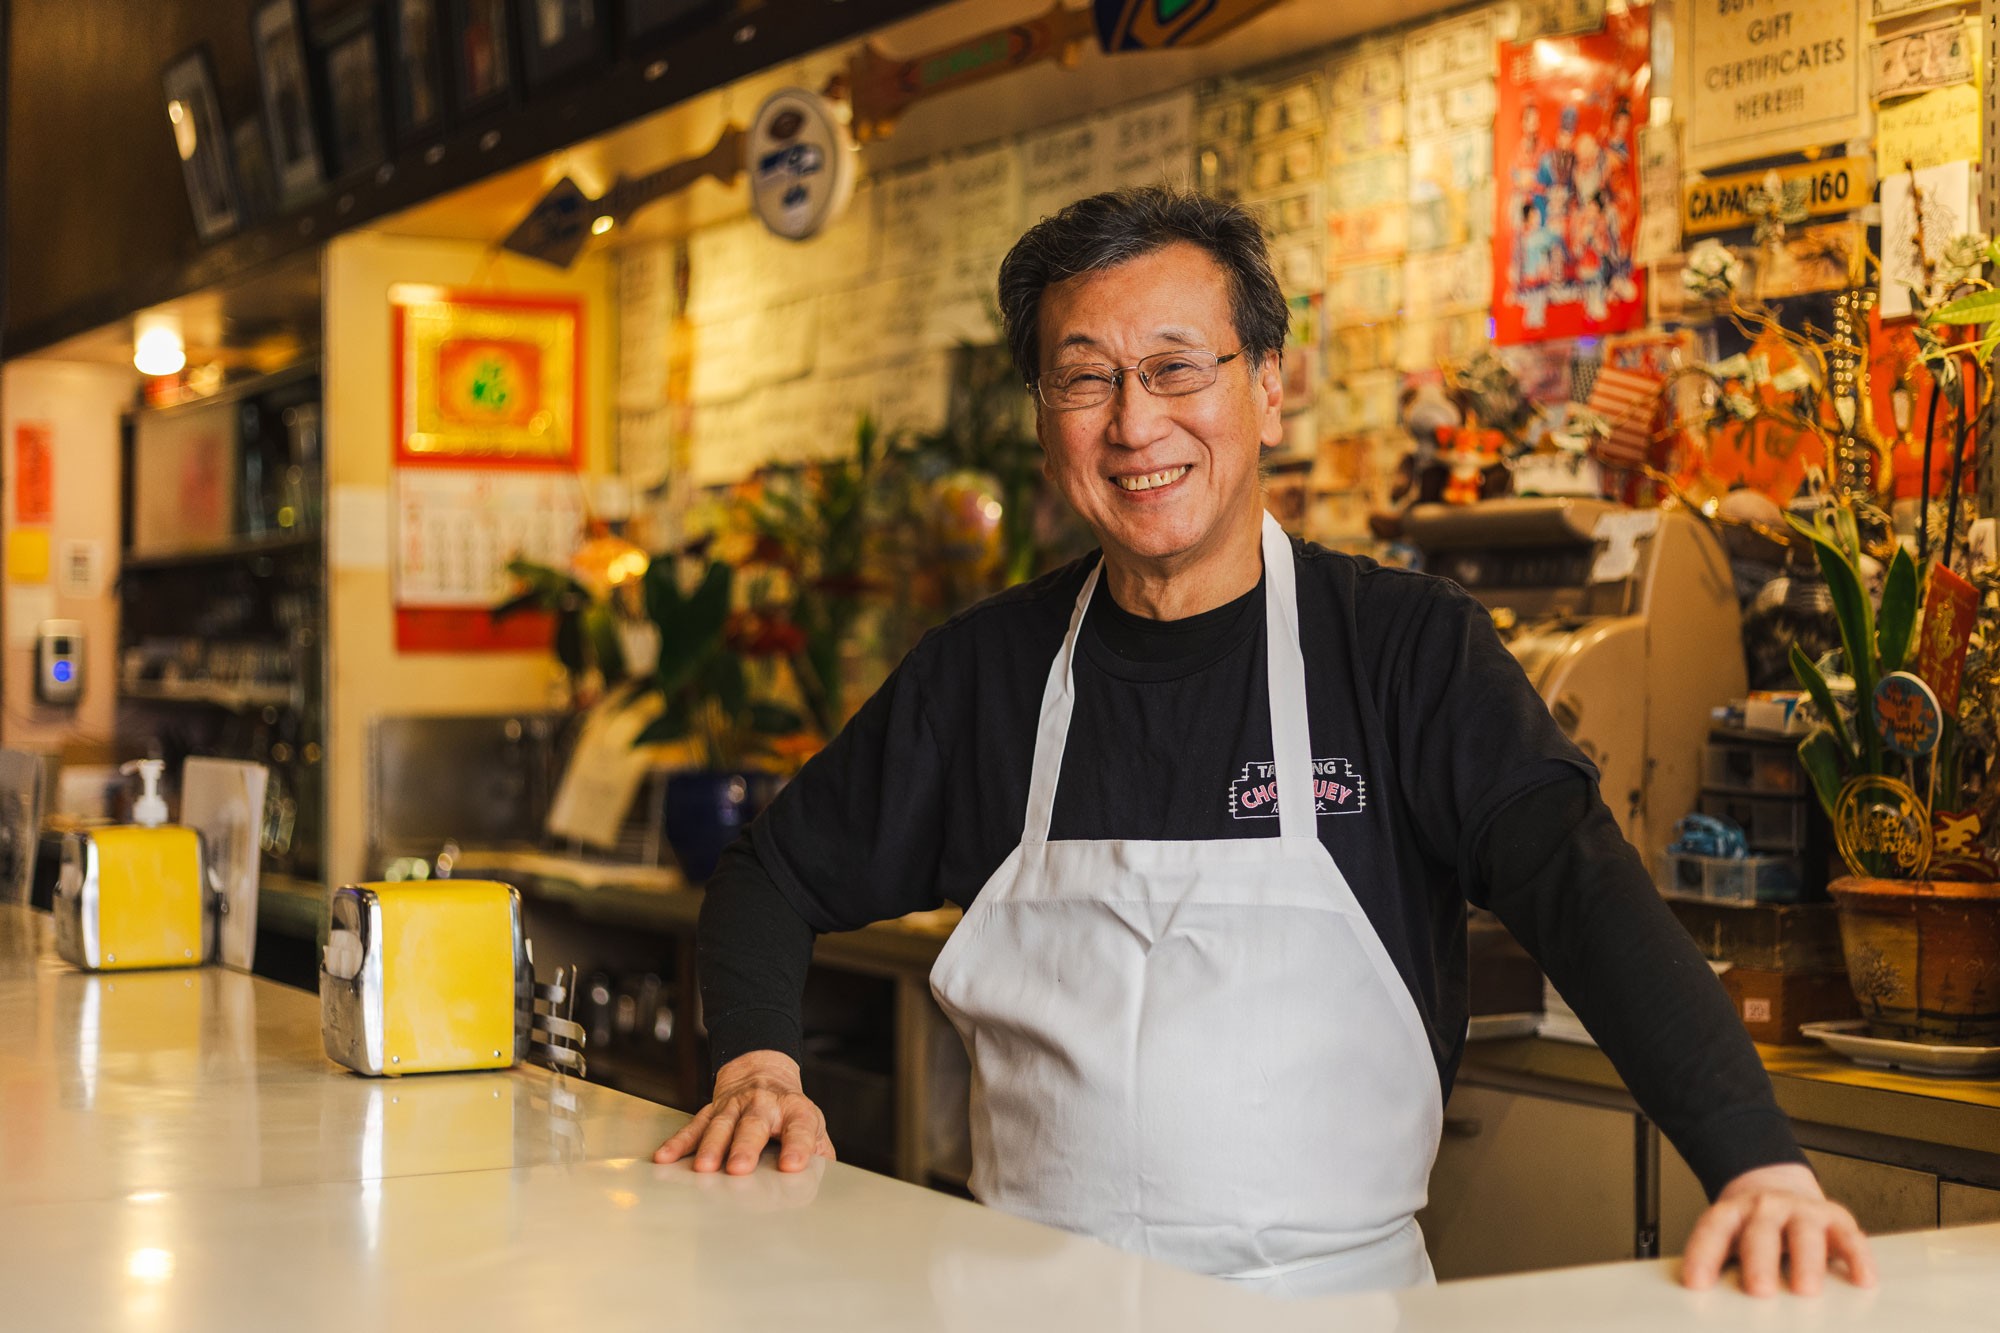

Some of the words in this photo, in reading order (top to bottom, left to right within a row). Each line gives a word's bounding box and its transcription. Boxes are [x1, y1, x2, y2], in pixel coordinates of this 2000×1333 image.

[1747, 11, 1792, 45] GIFT
[1705, 37, 1846, 92] CERTIFICATES
[1811, 171, 1849, 205] 160
[1257, 764, 1276, 778] TA
[1241, 781, 1278, 809] CHO
[1313, 779, 1353, 805] UEY
